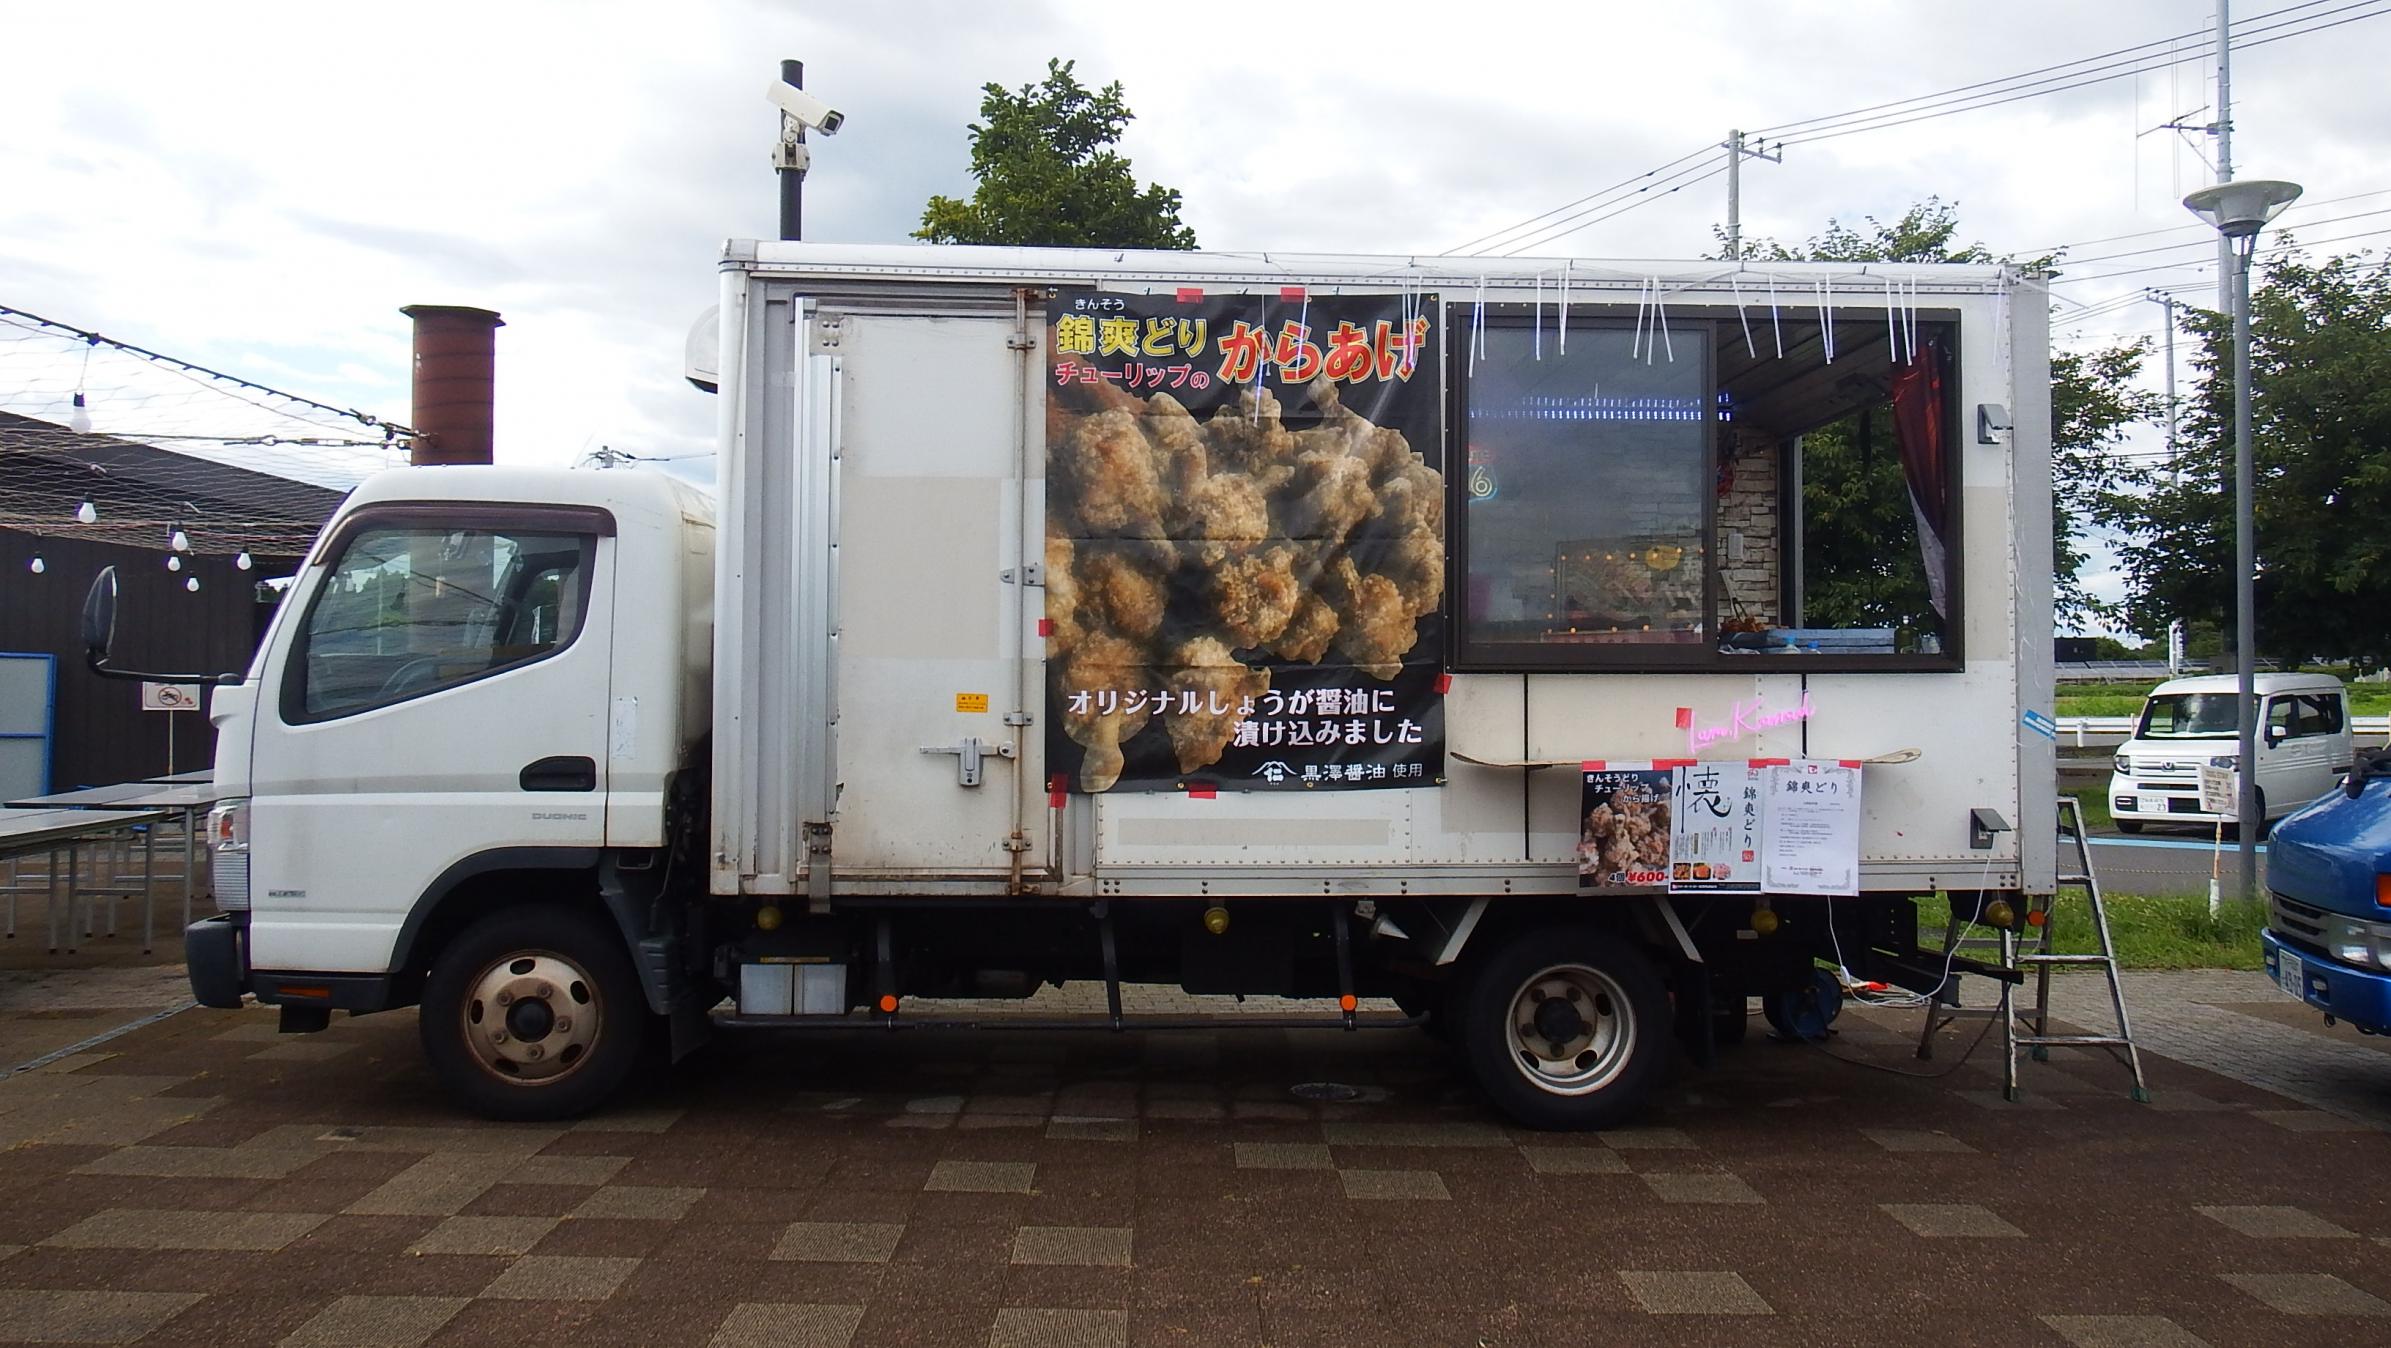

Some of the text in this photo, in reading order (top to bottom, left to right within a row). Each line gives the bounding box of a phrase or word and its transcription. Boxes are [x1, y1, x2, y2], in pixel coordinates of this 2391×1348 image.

[1074, 298, 1125, 311] きんそう
[1056, 313, 1207, 358] 錦爽どり
[1217, 316, 1431, 384] からあげ
[1055, 362, 1210, 390] チューリップの
[1067, 688, 1395, 717] オリジナルしょうが醤油に
[1232, 719, 1423, 748] 漬け込みました
[1392, 763, 1423, 778] 使用
[1586, 774, 1639, 783] きんそうどり
[1595, 784, 1649, 793] チューリップ
[1786, 779, 1839, 795] 錦爽どり
